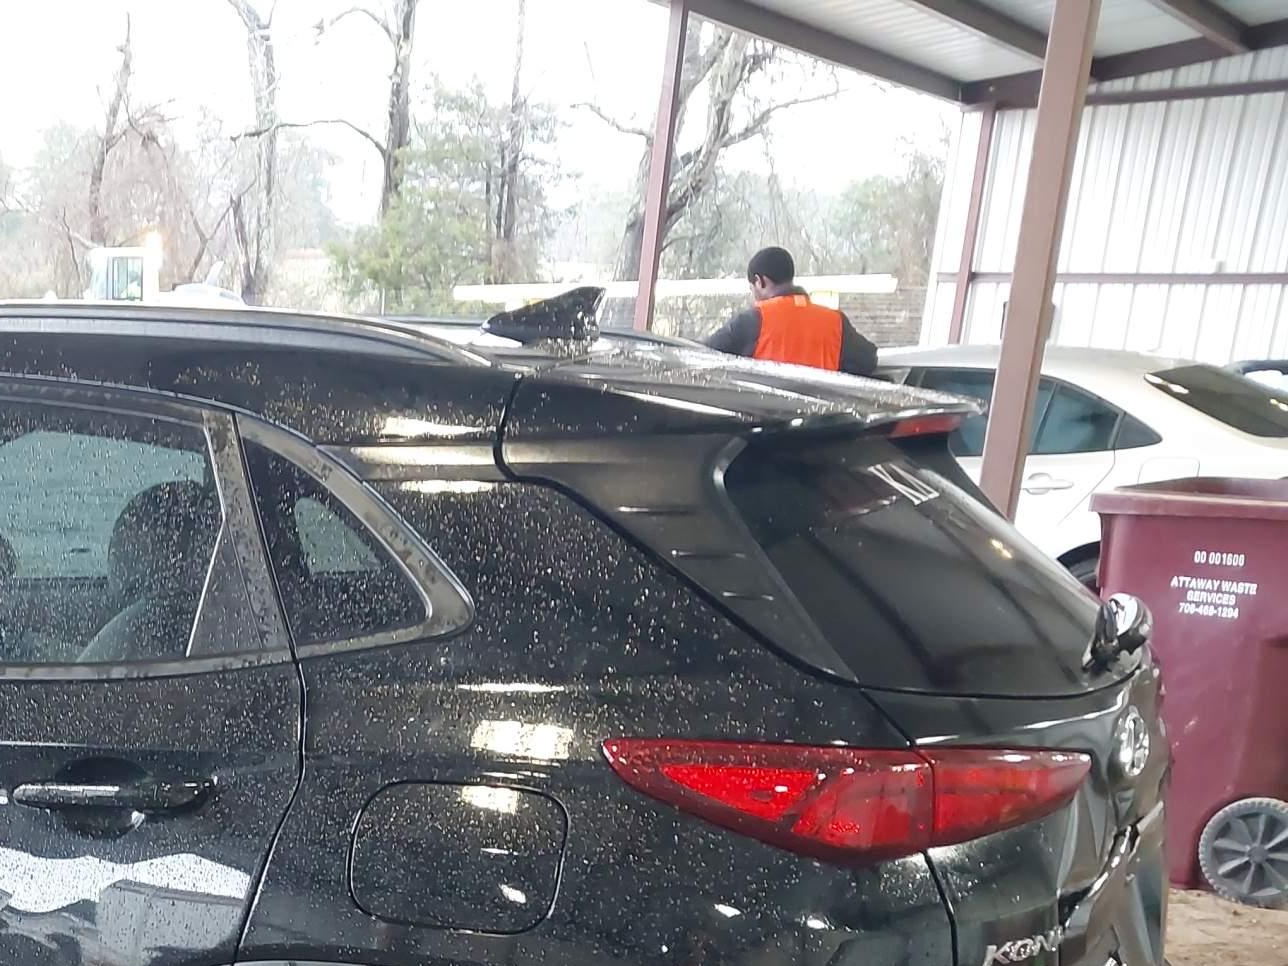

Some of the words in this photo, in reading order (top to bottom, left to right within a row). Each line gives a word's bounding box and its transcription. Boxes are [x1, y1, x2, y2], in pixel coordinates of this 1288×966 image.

[1170, 575, 1220, 591] ATTAWAY
[1221, 580, 1258, 595] WASTE
[1187, 590, 1236, 605] SERVICES
